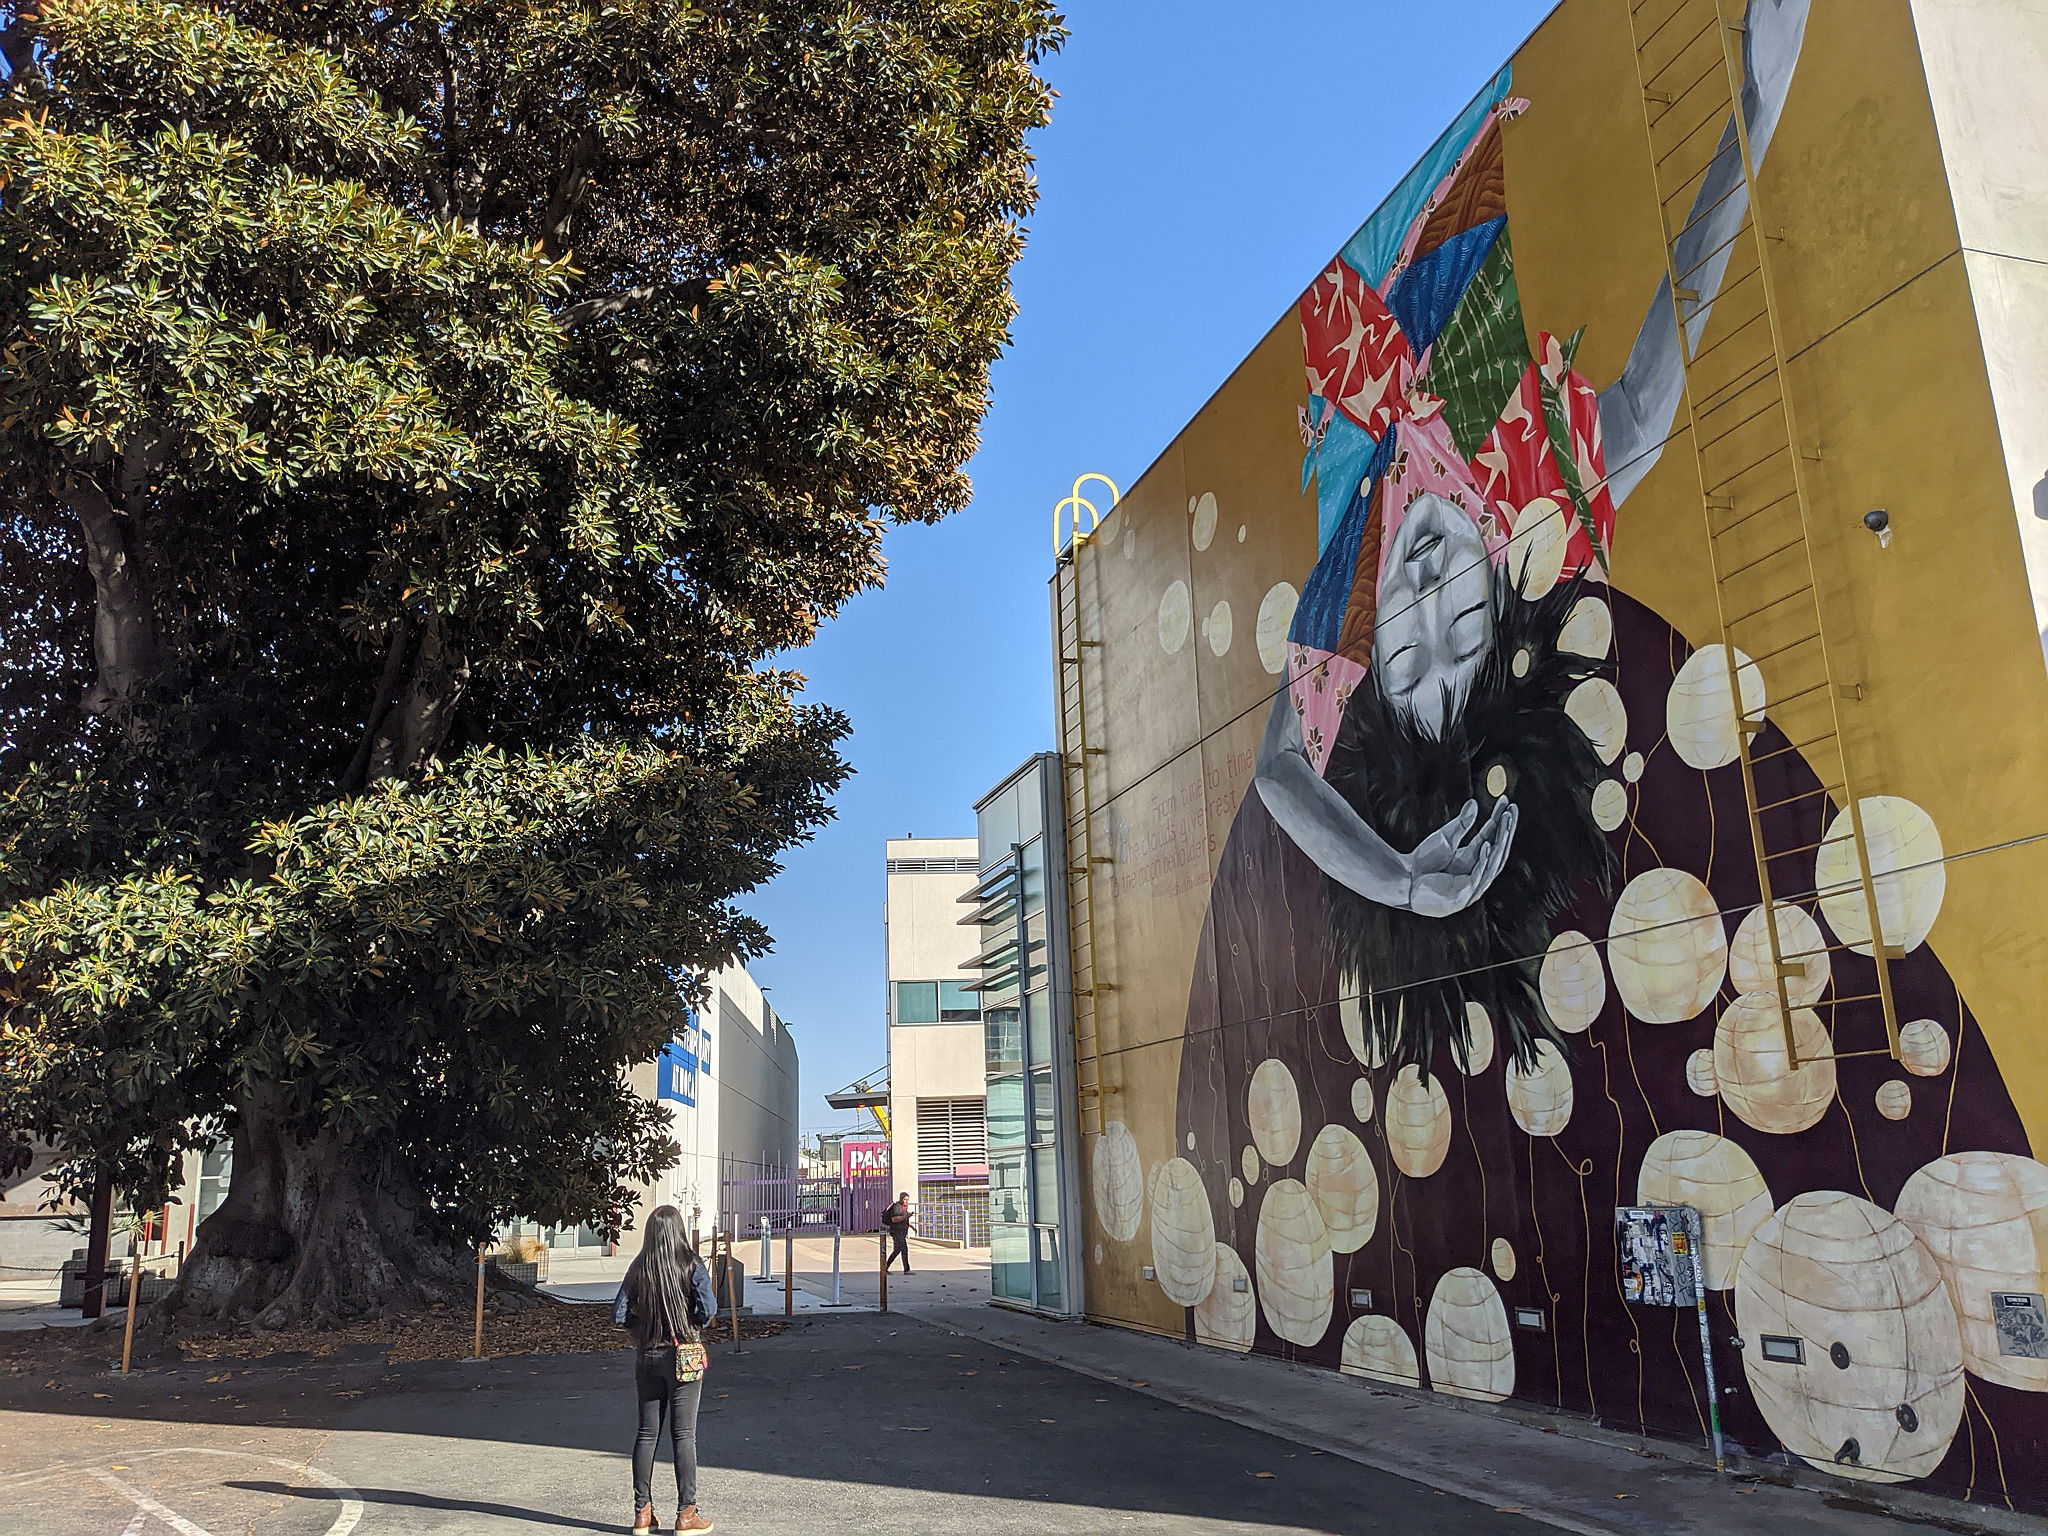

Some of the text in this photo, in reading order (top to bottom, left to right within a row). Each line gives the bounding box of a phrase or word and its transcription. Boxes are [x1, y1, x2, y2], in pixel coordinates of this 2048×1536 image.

[1179, 778, 1203, 806] time
[1206, 764, 1220, 791] to
[1227, 749, 1253, 779] time
[1143, 819, 1176, 856] clouds
[1180, 807, 1206, 845] give
[1209, 790, 1237, 821] rest
